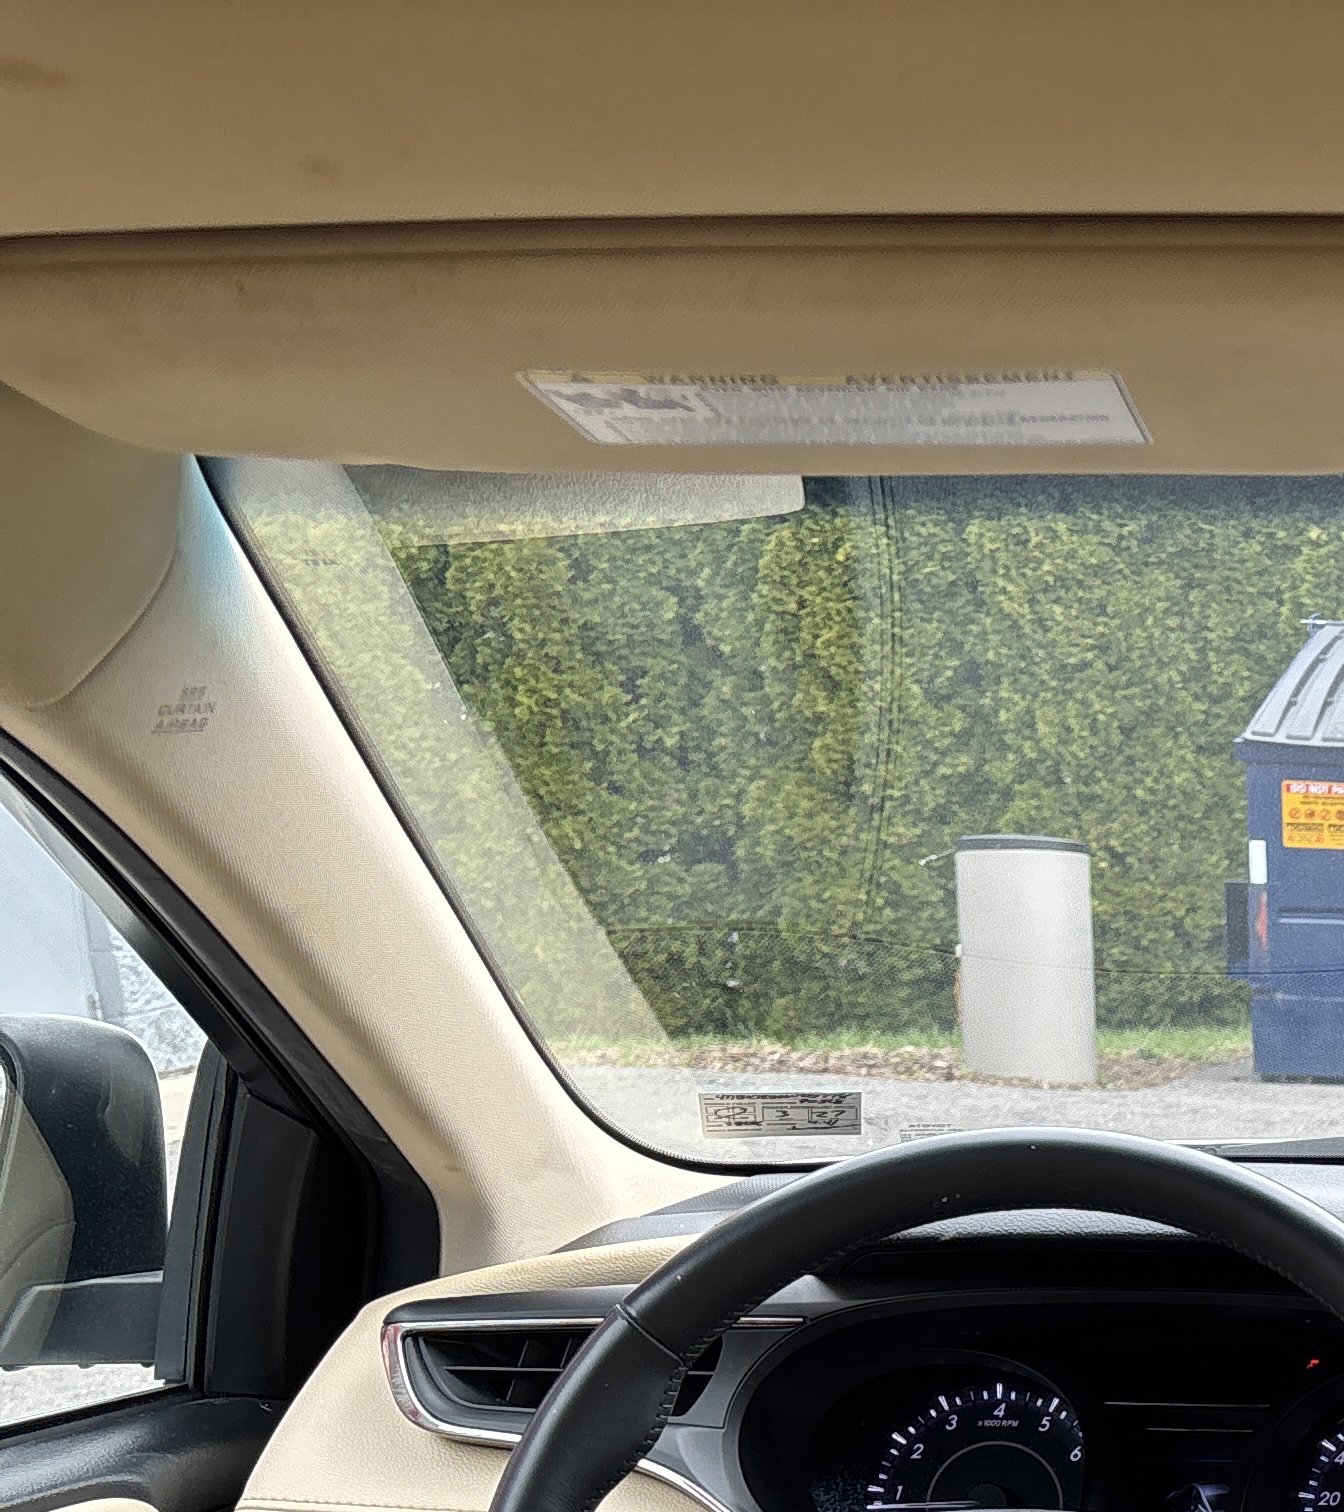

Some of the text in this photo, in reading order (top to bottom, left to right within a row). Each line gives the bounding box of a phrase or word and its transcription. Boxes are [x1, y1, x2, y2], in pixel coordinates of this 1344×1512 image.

[993, 1403, 1007, 1418] 4
[945, 1414, 958, 1431] 3
[1038, 1416, 1052, 1432] 5
[910, 1443, 925, 1459] 2
[1069, 1446, 1082, 1462] 6
[895, 1485, 903, 1501] 1
[1317, 1492, 1342, 1506] 20
